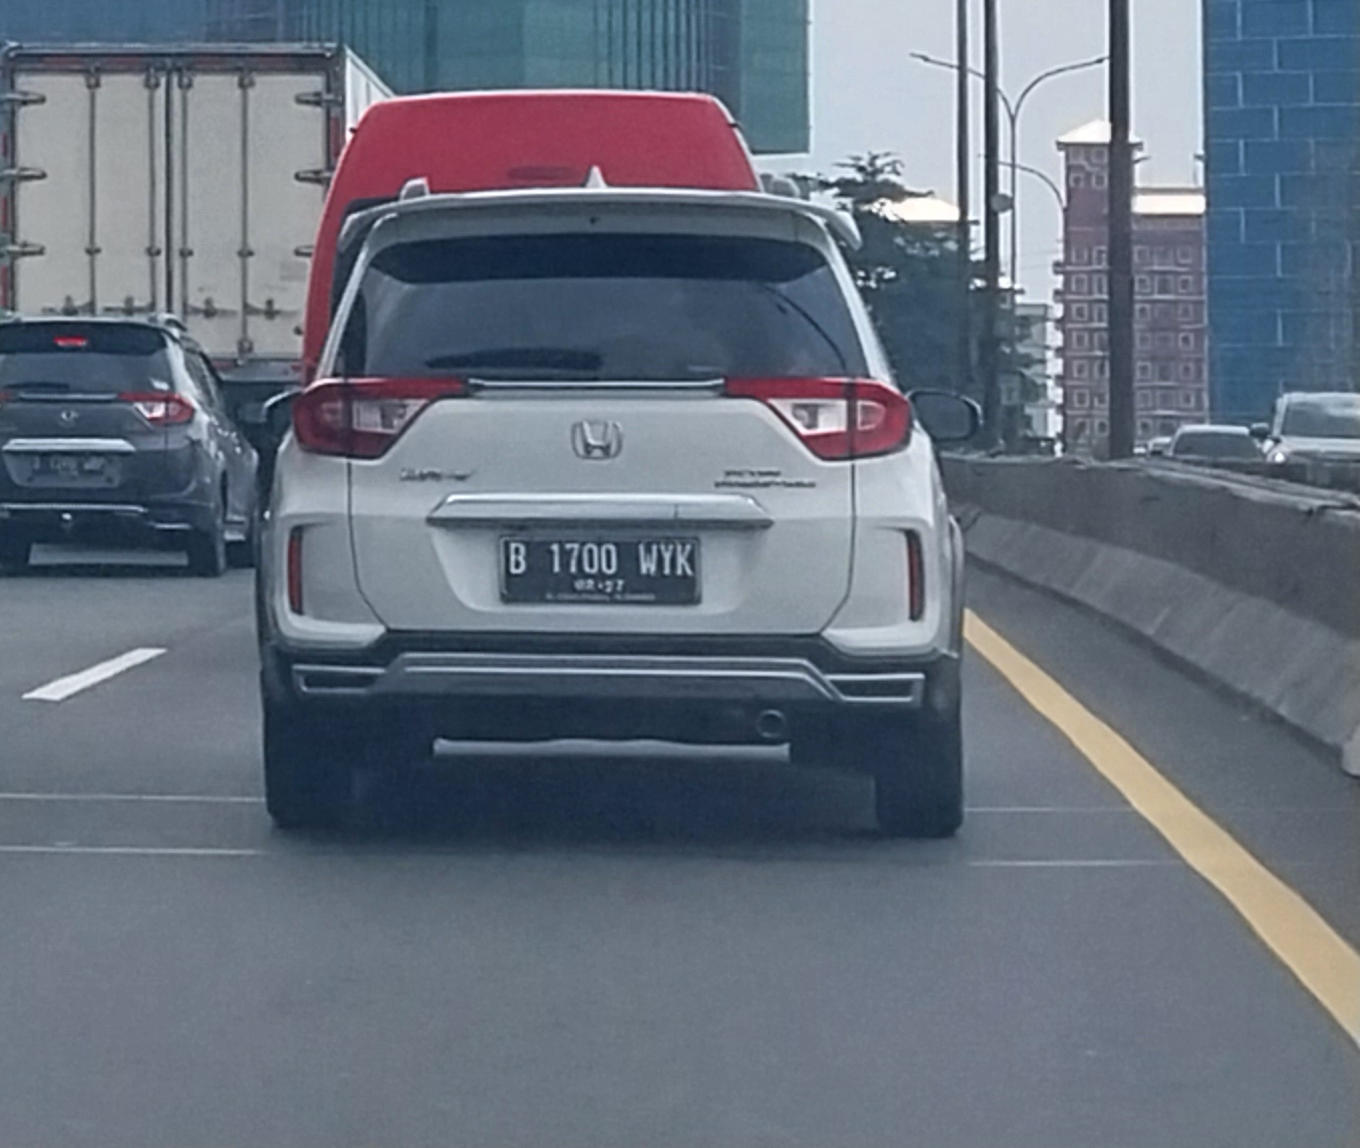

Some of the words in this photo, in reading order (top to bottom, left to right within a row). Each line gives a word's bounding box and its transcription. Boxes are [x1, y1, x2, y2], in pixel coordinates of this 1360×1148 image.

[509, 542, 527, 575] B
[549, 542, 618, 575] 1700
[637, 542, 694, 577] WYK
